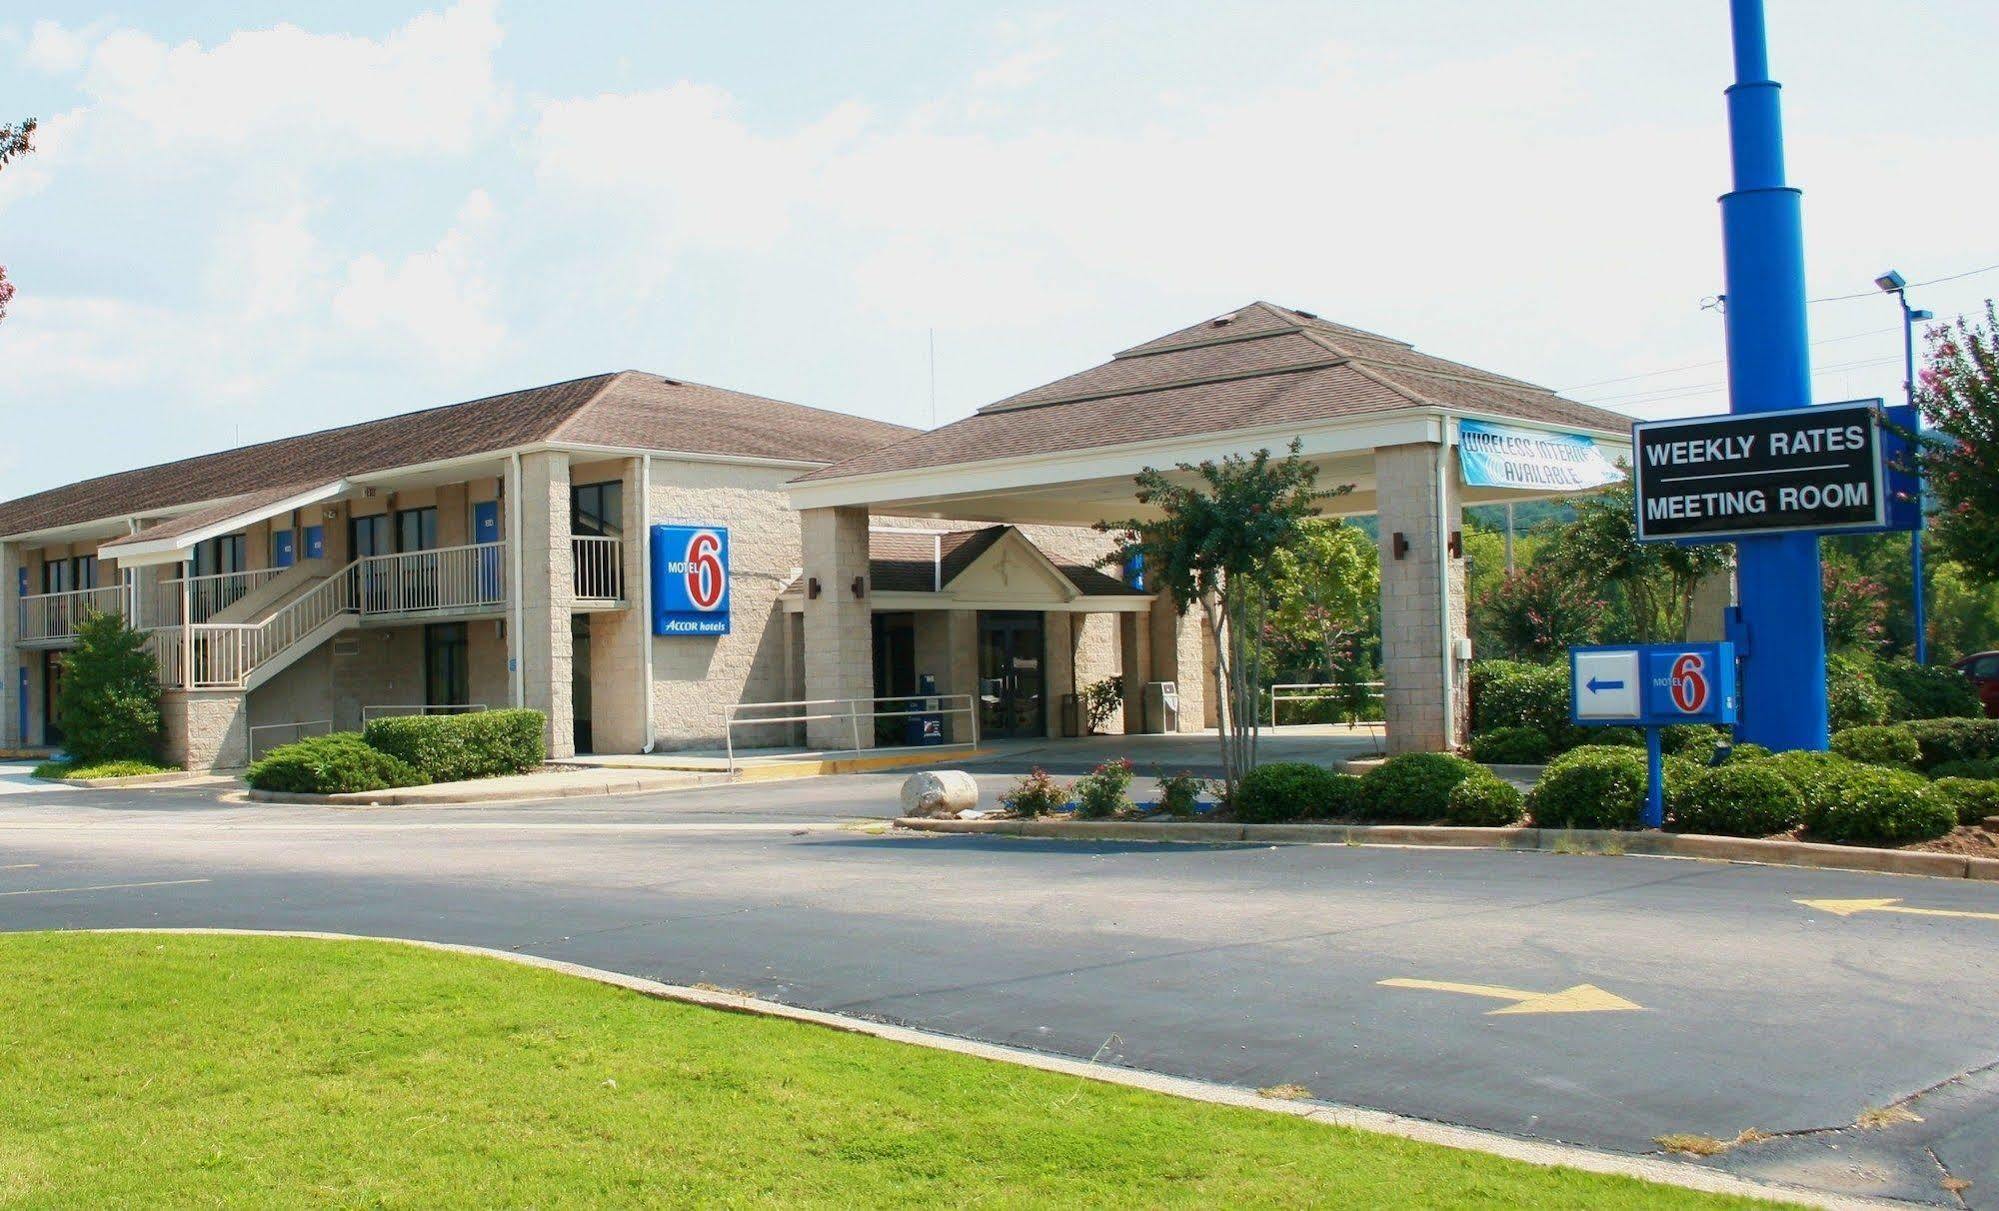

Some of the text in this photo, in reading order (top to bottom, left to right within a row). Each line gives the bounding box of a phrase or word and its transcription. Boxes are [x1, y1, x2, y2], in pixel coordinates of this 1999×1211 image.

[1462, 431, 1600, 463] WIRELESS INTERNE
[1646, 425, 1865, 467] WEEKLY RATES
[1504, 461, 1582, 485] AVAILABLE
[1647, 481, 1869, 520] MEETING ROOM
[668, 530, 726, 611] MOTEL 6
[666, 619, 726, 632] ACCOR hotels
[1653, 652, 1709, 714] MOTEL 6
